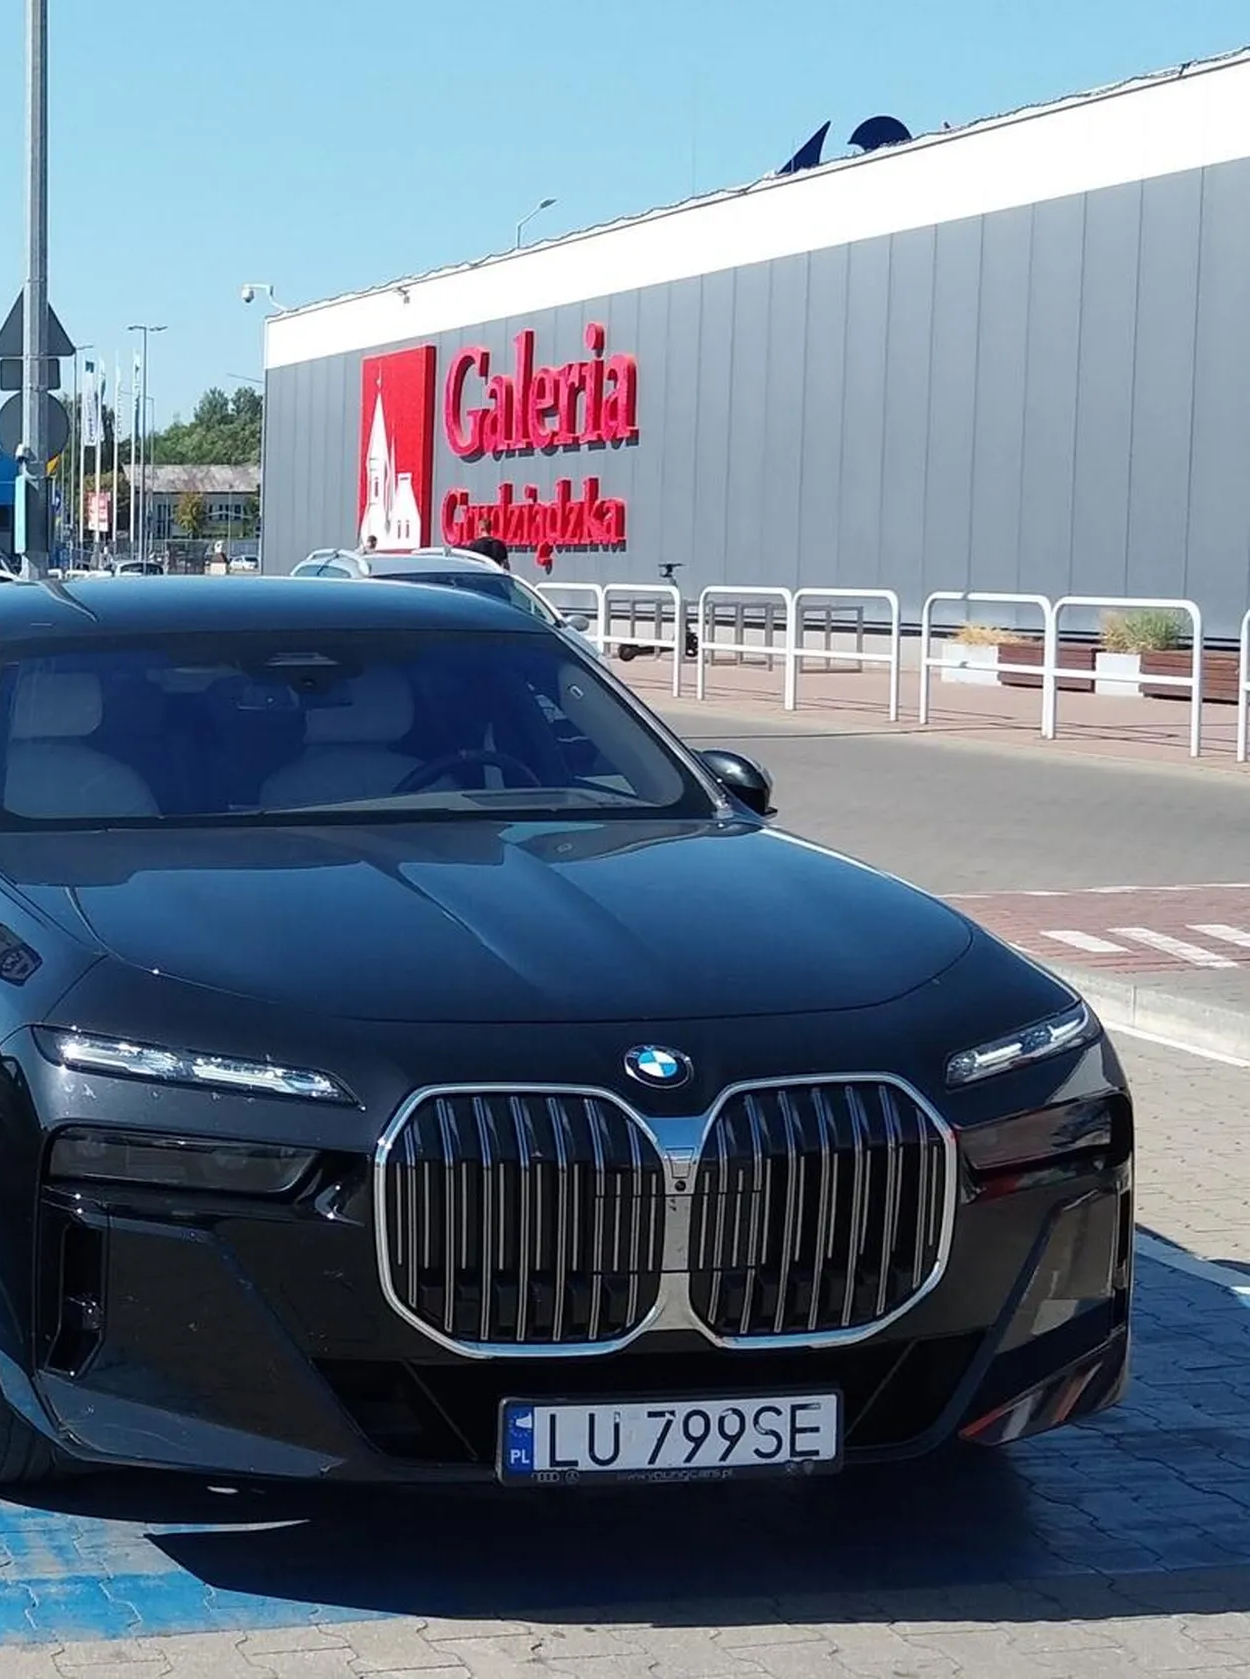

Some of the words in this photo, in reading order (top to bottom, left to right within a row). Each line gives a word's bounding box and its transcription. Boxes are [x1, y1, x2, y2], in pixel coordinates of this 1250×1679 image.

[444, 322, 640, 457] Galeria
[510, 1449, 530, 1464] PL
[549, 1413, 621, 1467] LU
[646, 1403, 821, 1465] 799SE
